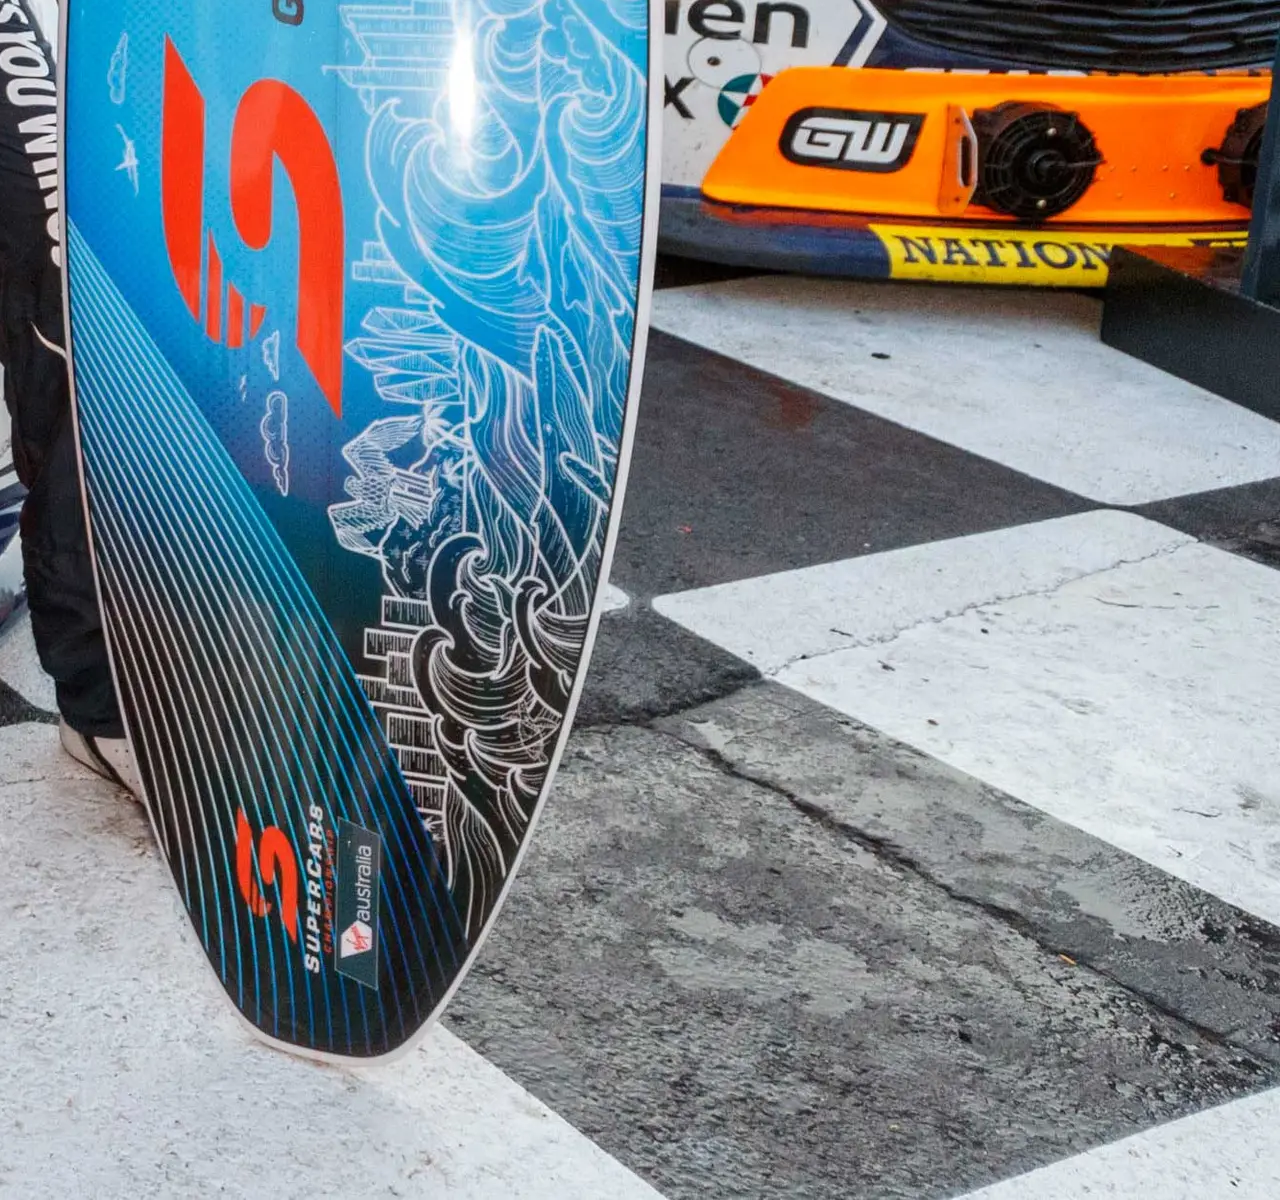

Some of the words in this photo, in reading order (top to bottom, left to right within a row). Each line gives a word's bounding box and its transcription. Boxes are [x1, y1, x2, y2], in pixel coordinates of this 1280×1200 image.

[791, 117, 912, 165] GW
[304, 804, 324, 974] SUPERCARS
[355, 844, 373, 923] australia
